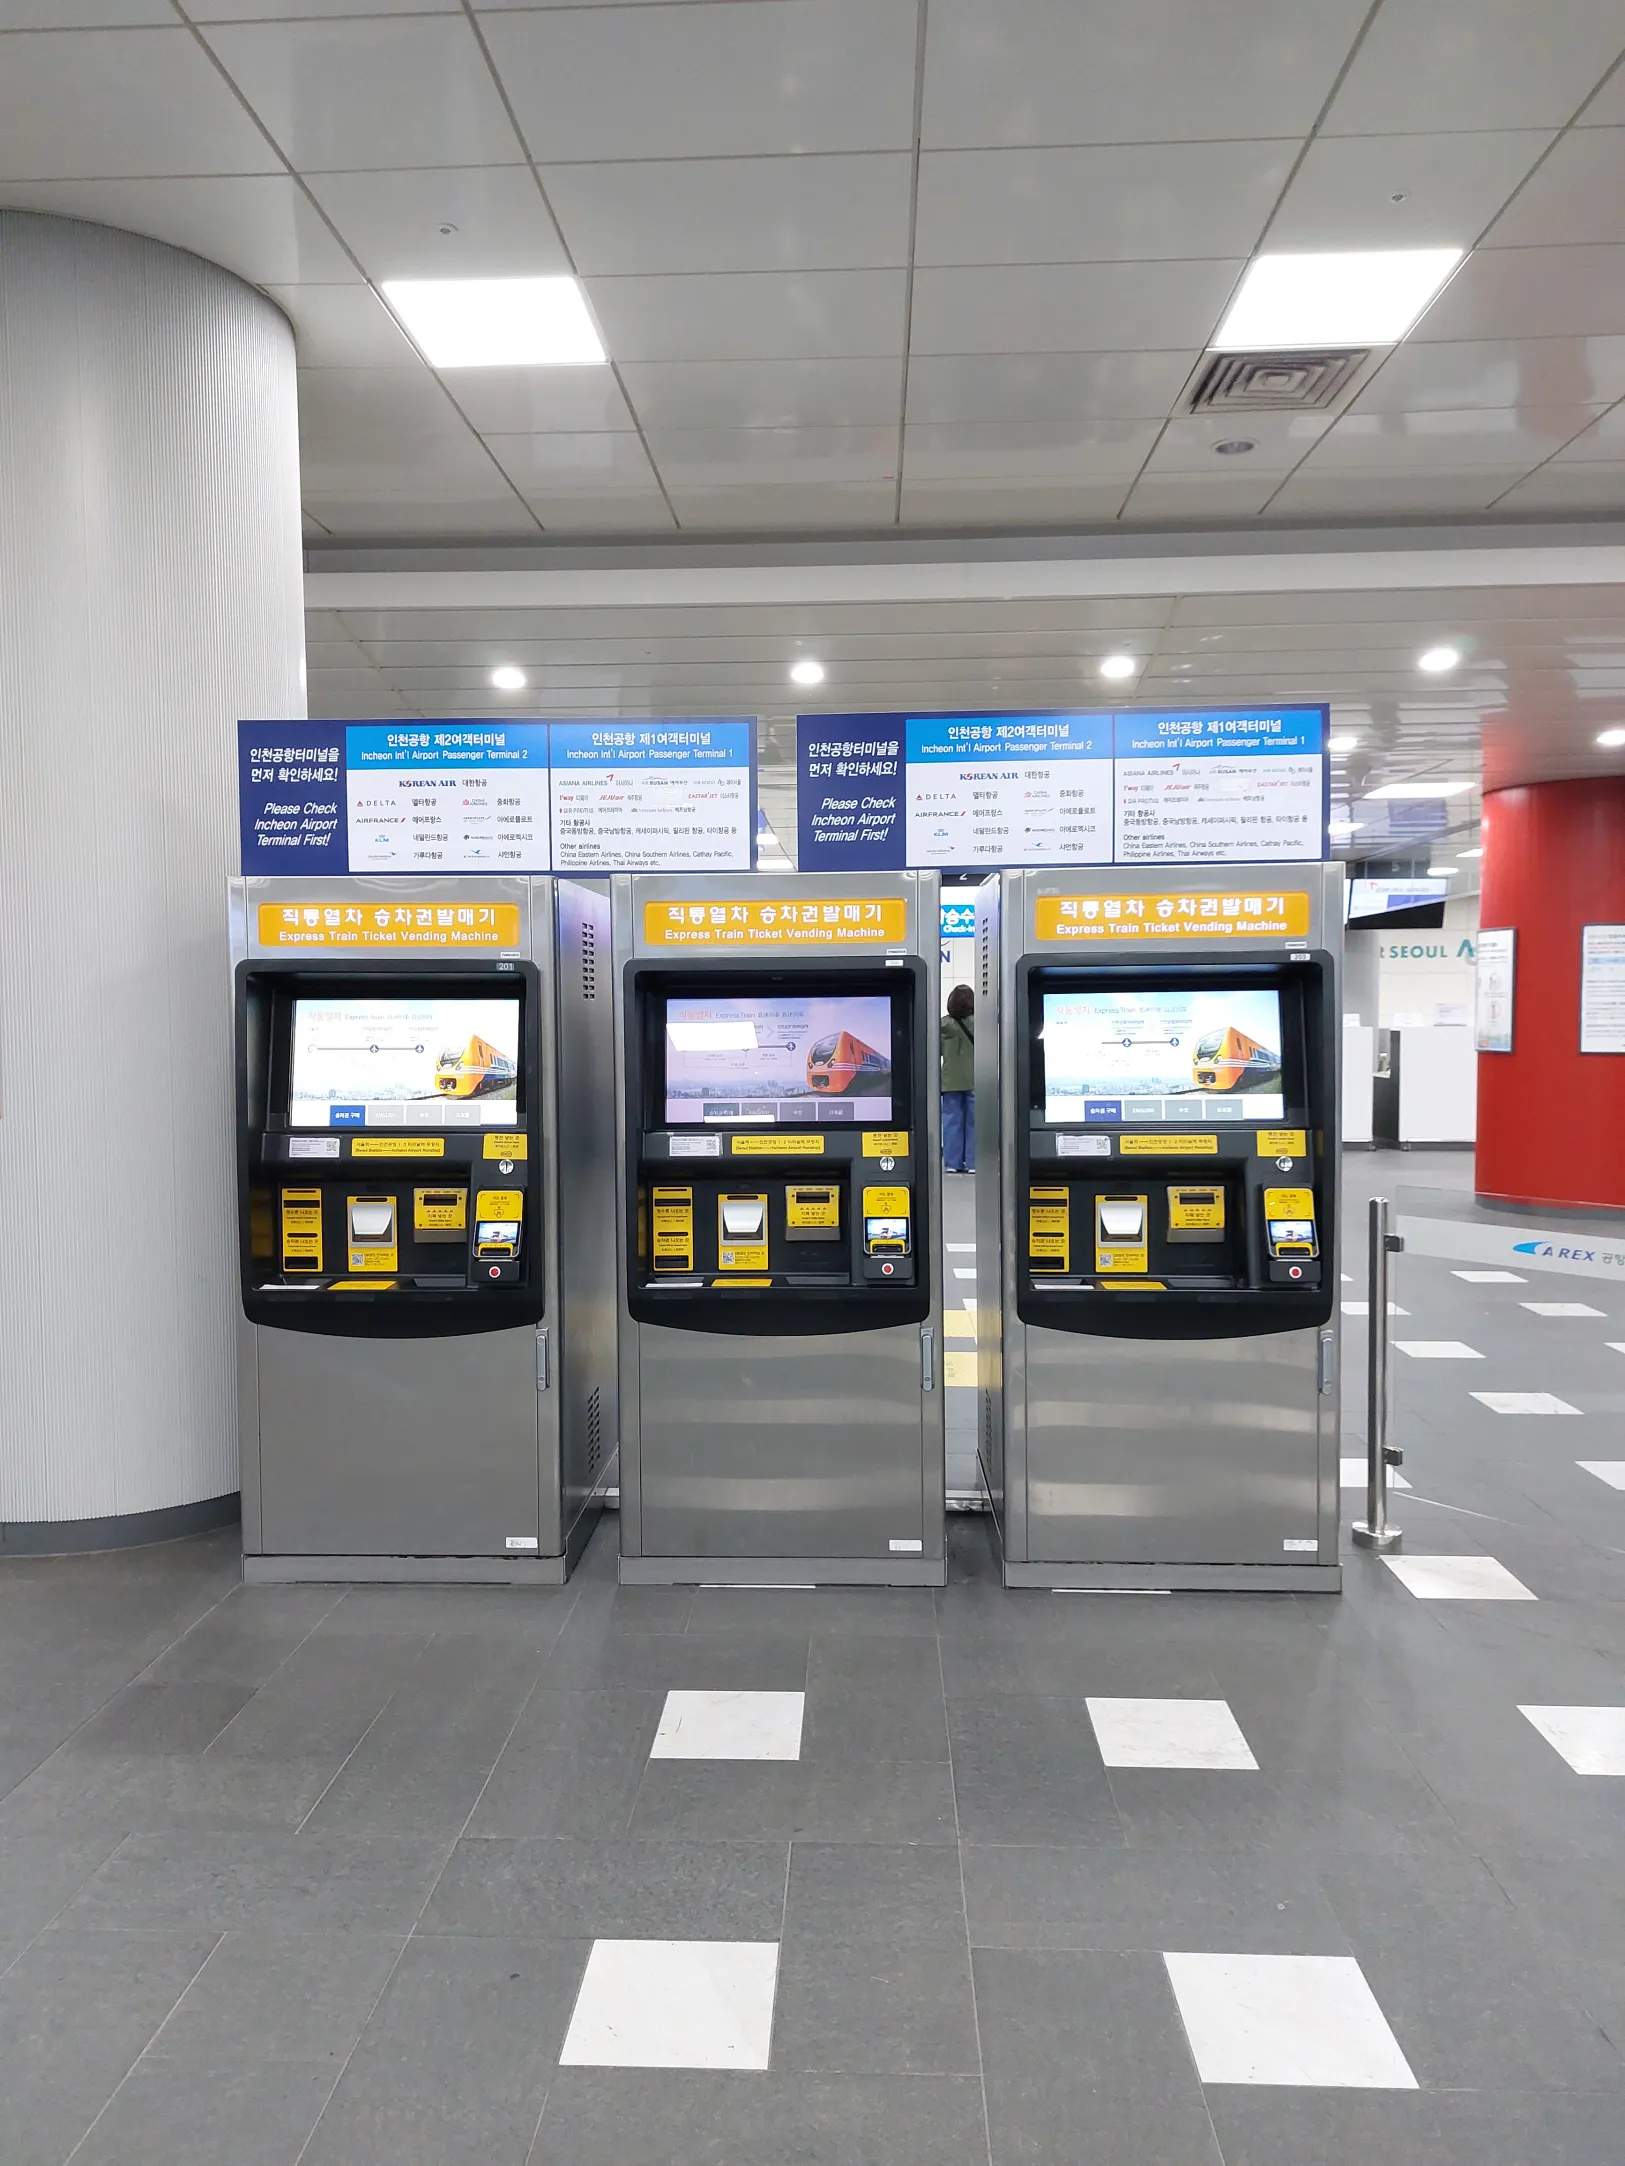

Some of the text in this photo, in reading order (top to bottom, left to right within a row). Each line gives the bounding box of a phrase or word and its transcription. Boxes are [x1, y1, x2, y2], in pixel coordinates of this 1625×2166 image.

[948, 725, 1069, 739] 인천공항 제2여객터미널
[1158, 720, 1281, 735] 인천공항 제1여객터미널
[387, 734, 505, 746] 인천공항 제2여객터미널
[592, 732, 711, 746] 인천공항 제1여객터미널
[1132, 736, 1305, 749] Incheon Int'l Airport Passenger Terminal 1
[809, 741, 899, 757] 인천공항터미널을
[921, 741, 1092, 754] Incheon Int'l Airport Passenger Terminal 2
[250, 748, 339, 763] 인천공항터미널을
[361, 750, 528, 761] Incheon Int'l Airport Passenger Terminal 2
[567, 749, 733, 759] Incheon Int'l Airport Passenger Terminal 1
[251, 768, 338, 782] 먼저 확인하세요!
[810, 762, 897, 777] 먼저 확인하세요!
[1025, 771, 1050, 779] 대한항공
[462, 778, 487, 787] 대한항공
[973, 791, 998, 799] 델타항공
[264, 802, 337, 814] Please Check
[412, 798, 437, 806] 델타항공
[497, 798, 521, 806] 중화항공
[821, 797, 896, 810] Please Check
[973, 809, 1003, 817] 에어프랑스
[254, 818, 337, 831] Incheon Airport
[412, 816, 442, 824] 에어프랑스
[812, 814, 896, 826] Incheon Airport
[973, 826, 1009, 835] 네덜란드항공
[1059, 825, 1096, 833] 아에로멕시코
[257, 834, 330, 846] Terminal First!
[413, 833, 448, 842] 네덜란드항공
[497, 833, 533, 841] 아에로멕시코
[813, 829, 889, 842] Terminal First!
[973, 845, 1003, 853] 가루다항공
[413, 851, 443, 860] 가루다항공
[1061, 898, 1285, 918] 직통열차 승차권발매기
[282, 908, 495, 926] 직통열차 승차권발매기
[668, 905, 882, 924] 직통열차 승차권발매기
[665, 928, 885, 940] Express Train Ticket Vending Machine
[1056, 921, 1287, 935] Express Train Ticket Vending Machine
[280, 931, 498, 942] Express Train Ticket Vending Machine
[1389, 946, 1447, 958] SEOUL
[499, 962, 513, 970] 201
